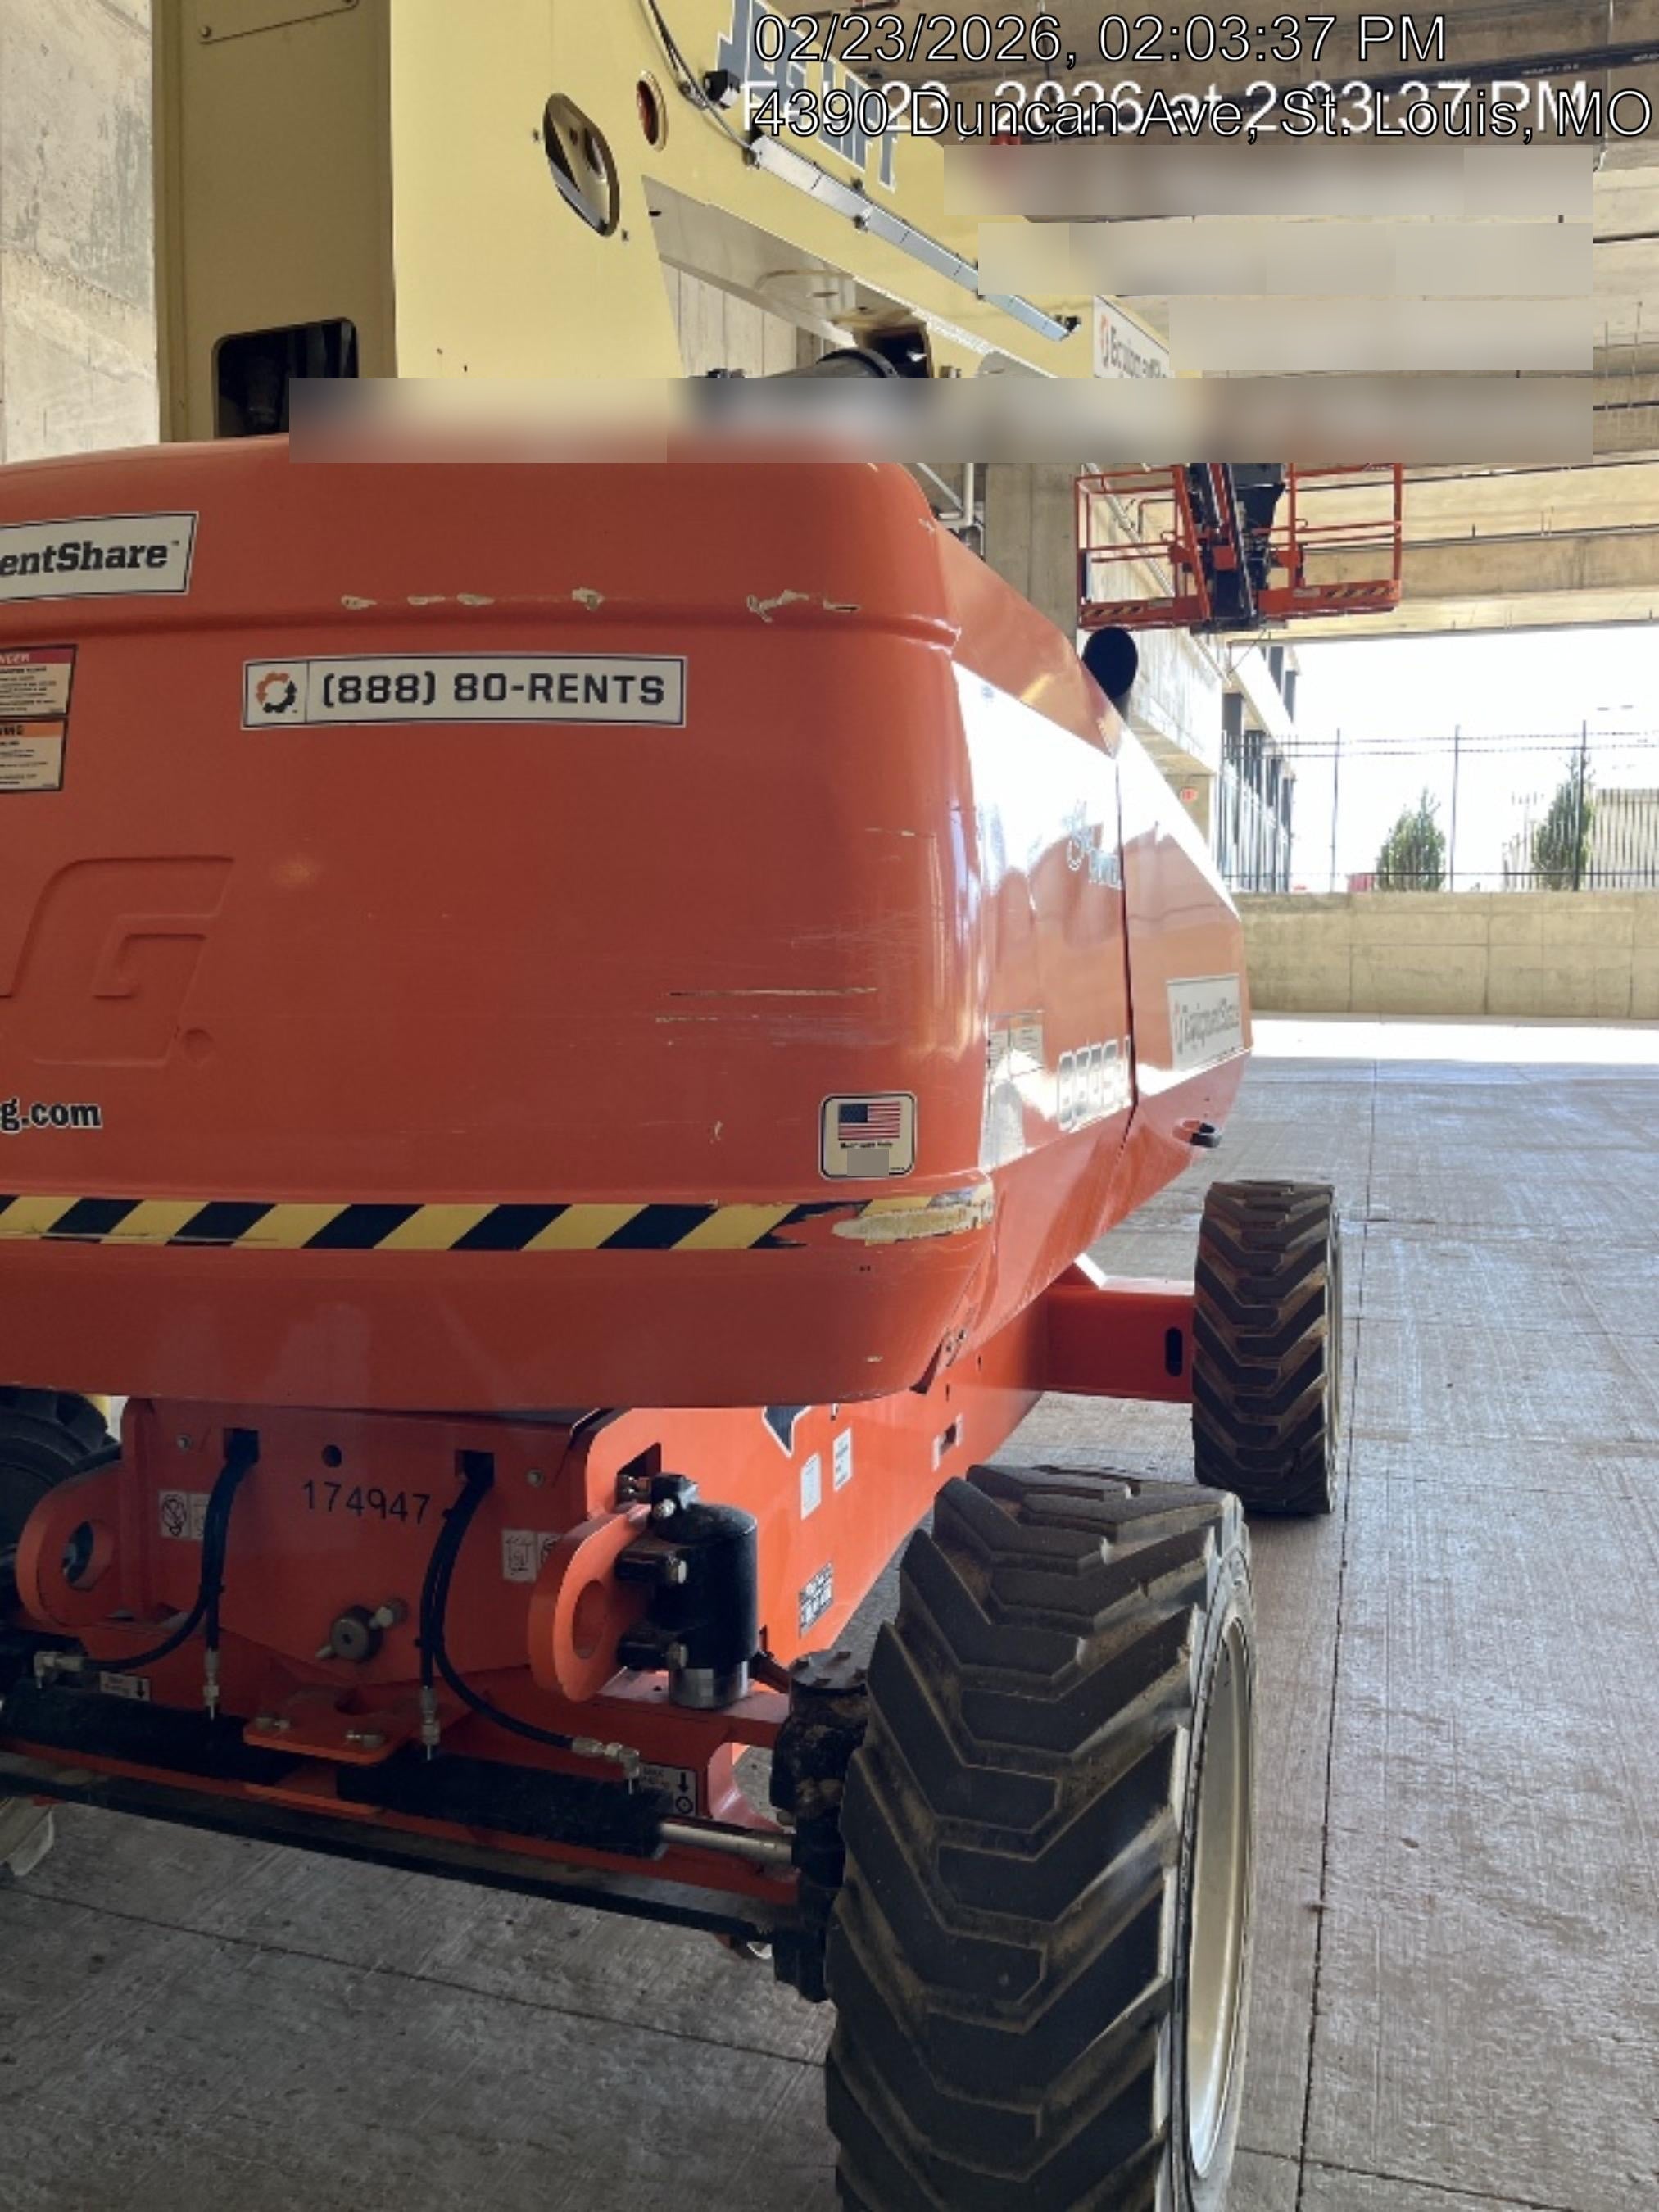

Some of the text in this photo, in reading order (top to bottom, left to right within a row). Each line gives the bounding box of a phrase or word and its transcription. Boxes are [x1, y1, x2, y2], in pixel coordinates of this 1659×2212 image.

[322, 670, 666, 709] (888) 80-RENTS
[303, 1479, 431, 1525] 174947
